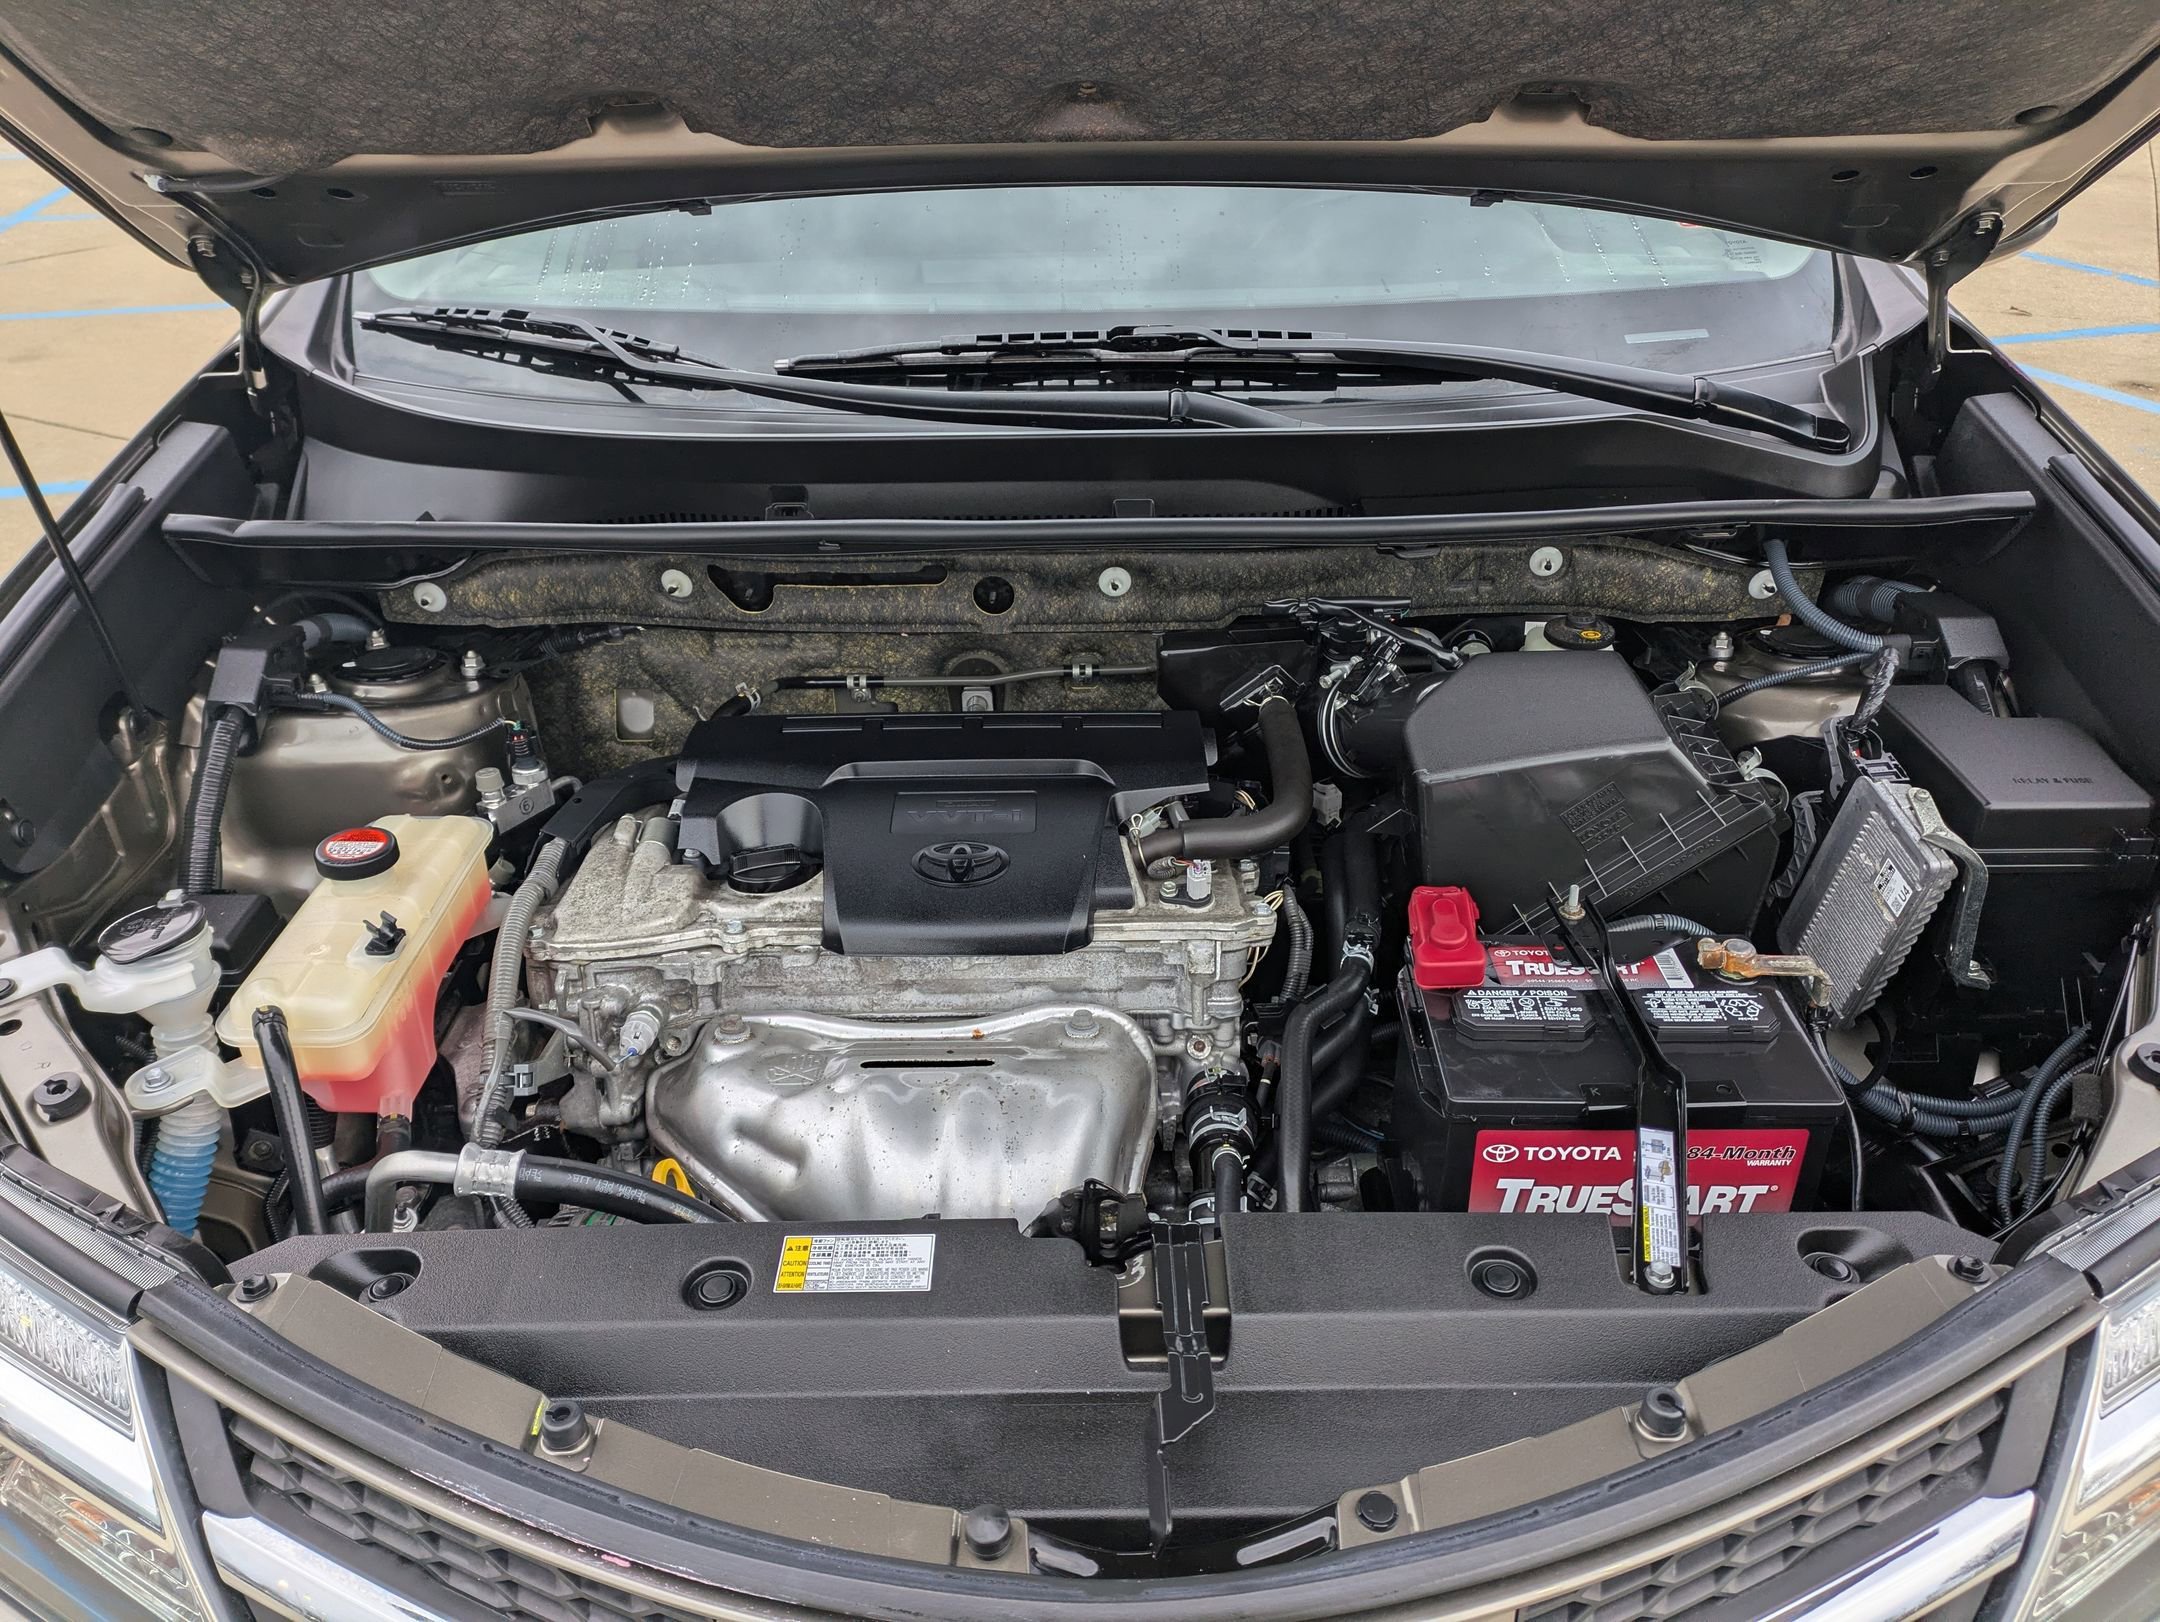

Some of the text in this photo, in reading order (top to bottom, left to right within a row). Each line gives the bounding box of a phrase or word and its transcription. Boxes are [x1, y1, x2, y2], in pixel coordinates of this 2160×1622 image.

[1511, 949, 1549, 957] TOYOT
[1523, 1147, 1621, 1161] TOYOTA
[1687, 1146, 1796, 1160] 84-Month
[1747, 1159, 1793, 1167] WARRANTY
